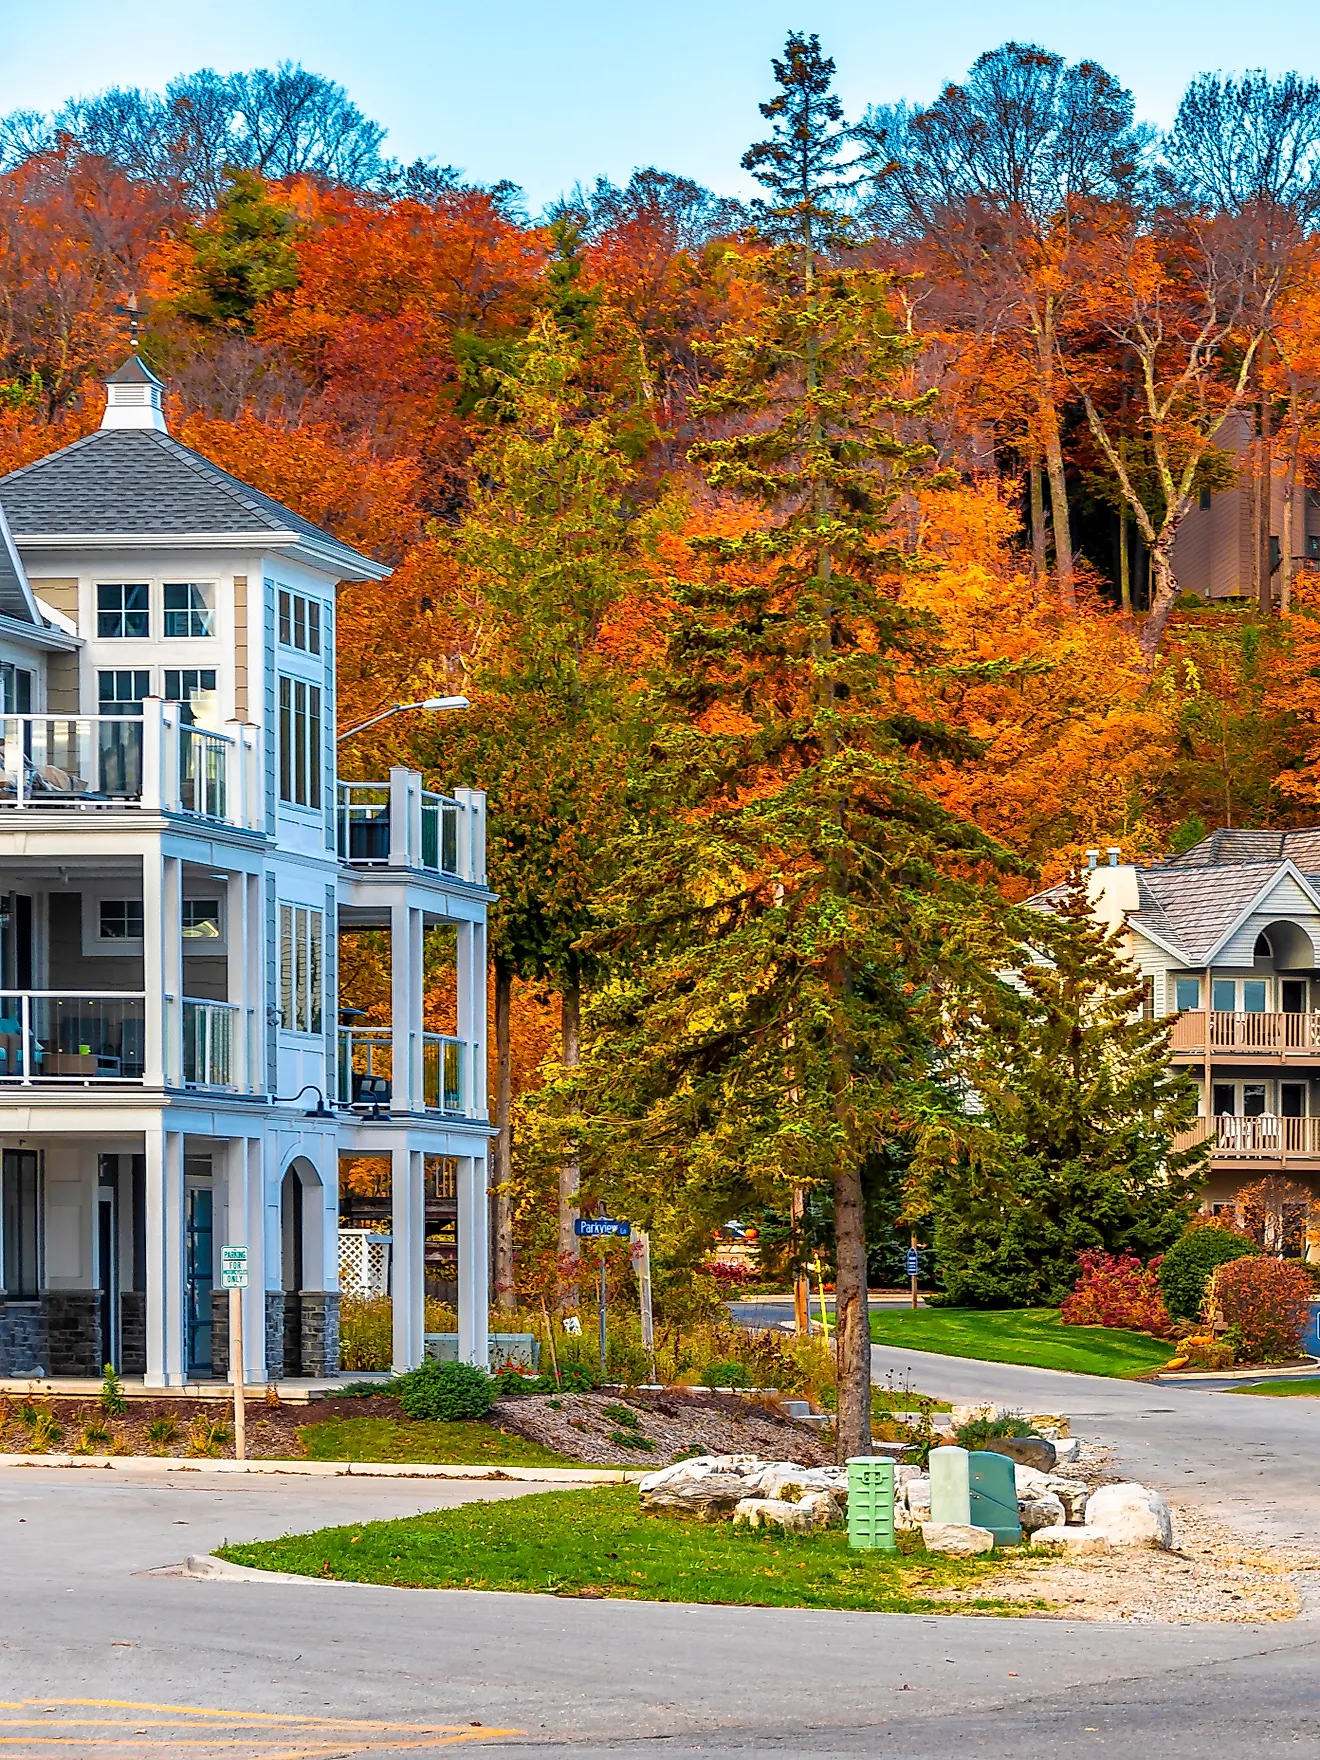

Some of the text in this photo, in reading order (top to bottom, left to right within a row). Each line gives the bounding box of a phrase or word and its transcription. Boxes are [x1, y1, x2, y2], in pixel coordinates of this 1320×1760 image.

[580, 1221, 619, 1234] Parkview
[229, 1261, 241, 1269] FOR
[227, 1275, 243, 1283] ONLY
